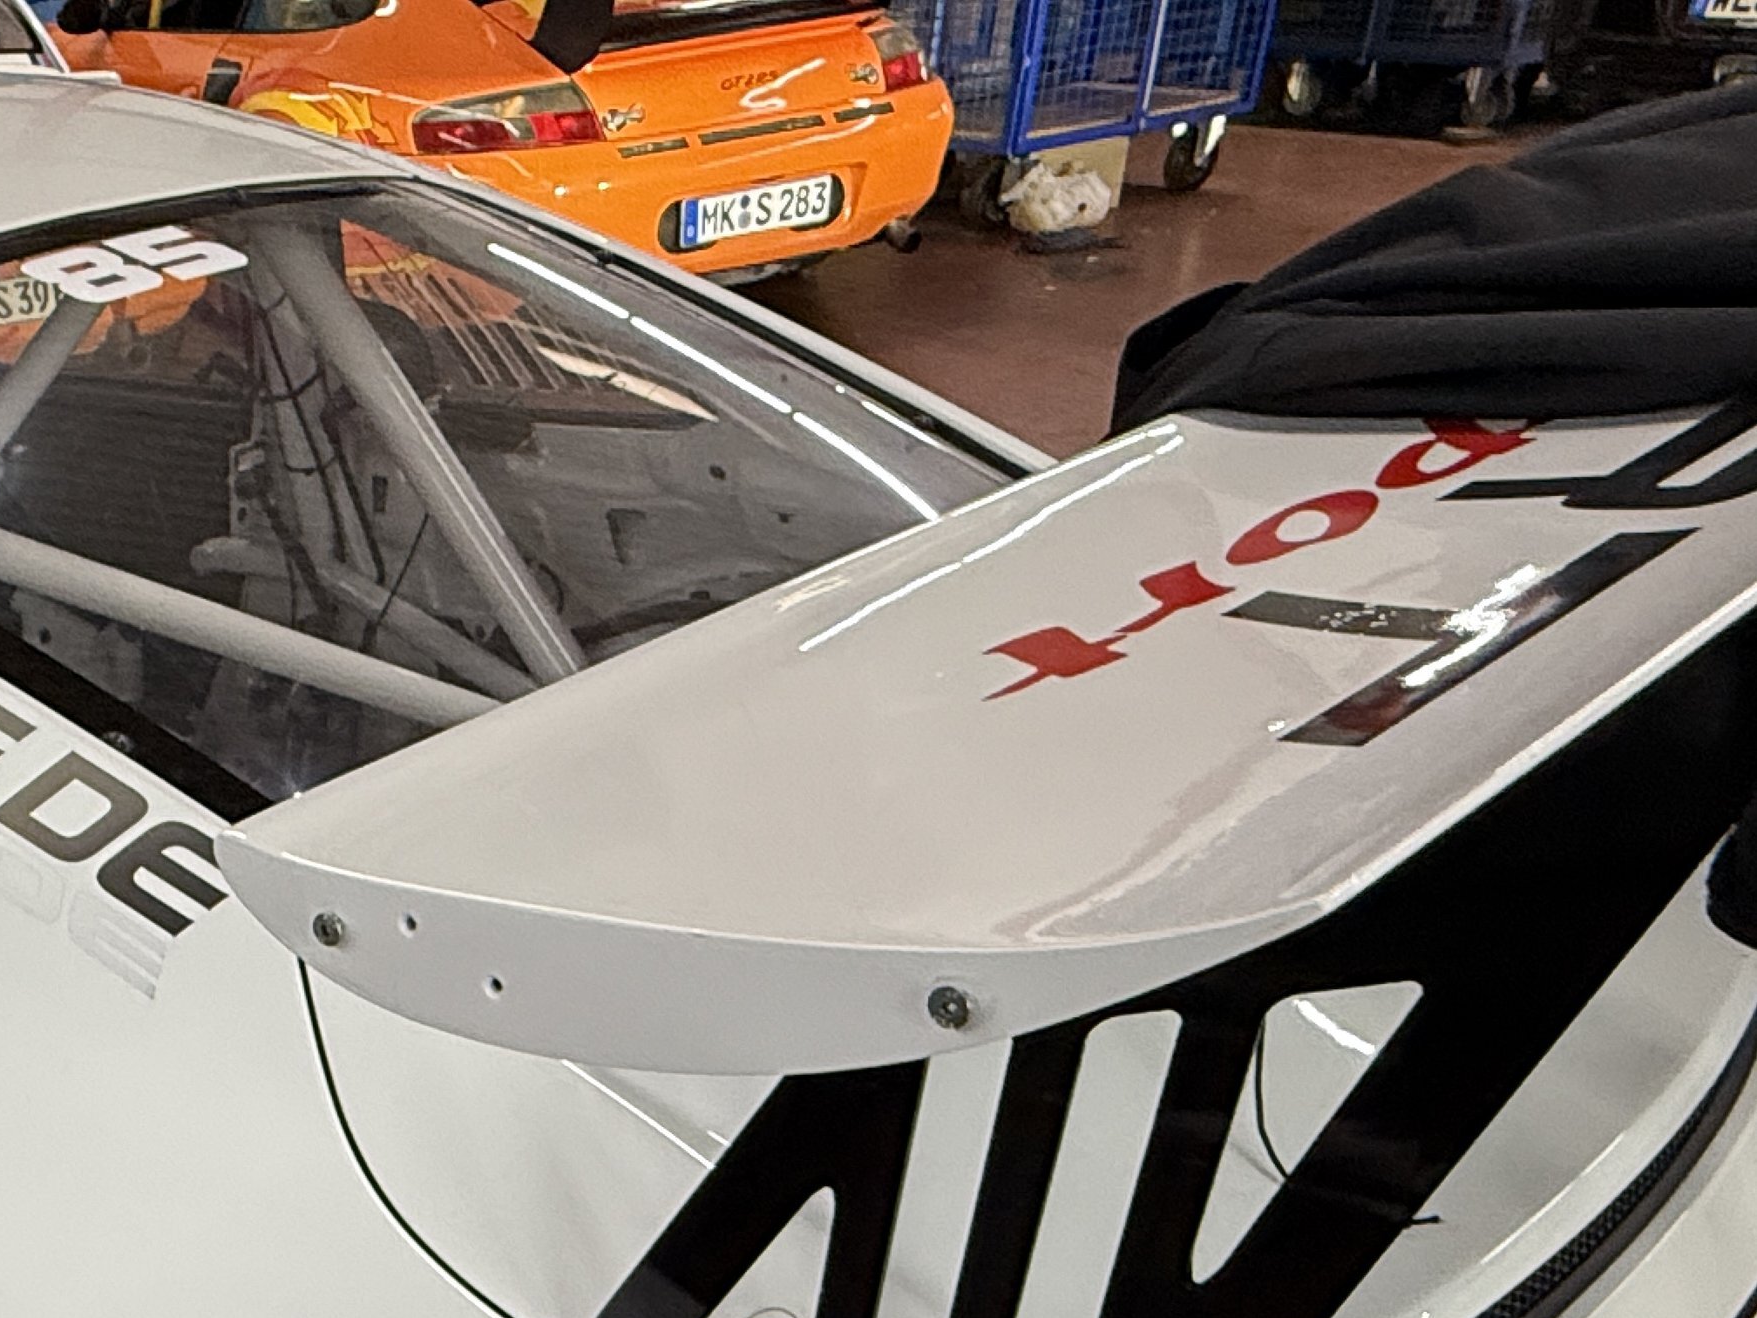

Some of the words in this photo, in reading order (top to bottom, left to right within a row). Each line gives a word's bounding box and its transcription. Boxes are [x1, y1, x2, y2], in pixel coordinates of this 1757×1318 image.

[701, 198, 737, 236] MK
[755, 192, 773, 226] S
[779, 181, 828, 222] 283
[20, 225, 249, 303] 85
